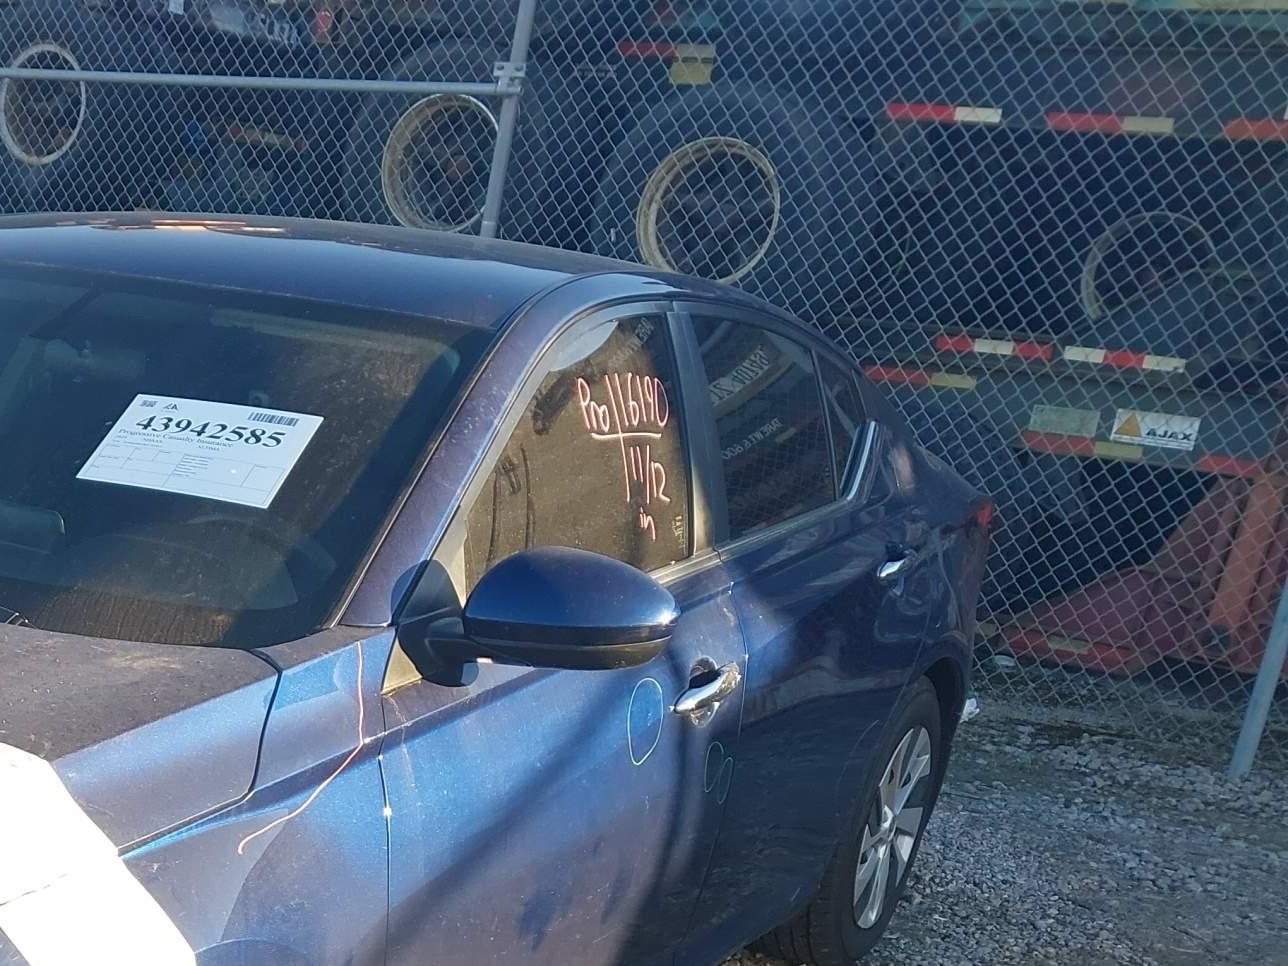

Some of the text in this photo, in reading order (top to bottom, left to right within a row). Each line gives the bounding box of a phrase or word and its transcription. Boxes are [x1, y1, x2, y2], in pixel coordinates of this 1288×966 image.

[135, 415, 286, 448] 43942585
[1145, 427, 1193, 441] AJAX
[162, 433, 195, 443] Casualty
[197, 437, 234, 448] Insurance
